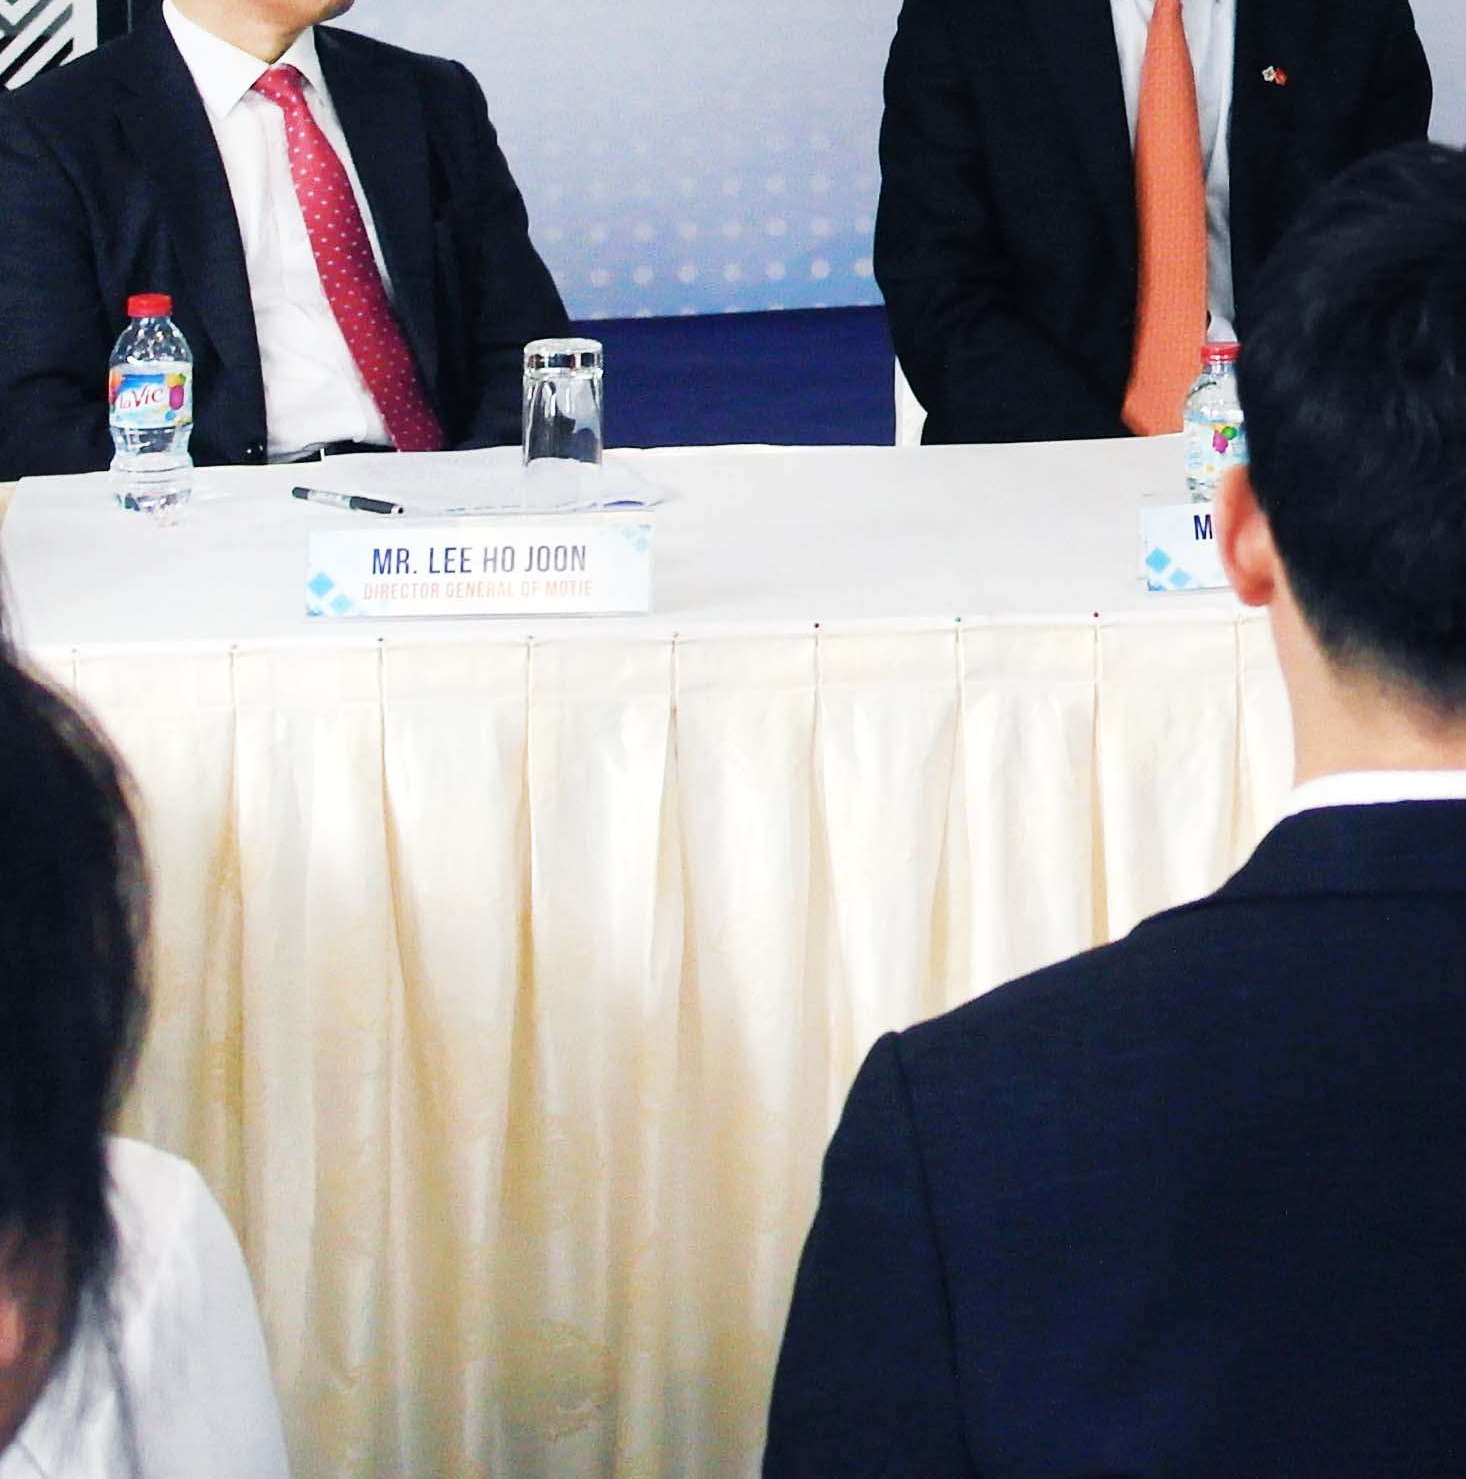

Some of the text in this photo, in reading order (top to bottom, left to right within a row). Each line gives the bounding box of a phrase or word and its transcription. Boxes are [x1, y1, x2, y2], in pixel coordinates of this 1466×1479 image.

[372, 545, 586, 574] MR. LEE HO JOON
[364, 580, 592, 600] DIRECTOR GENERAL OF MOTIE
